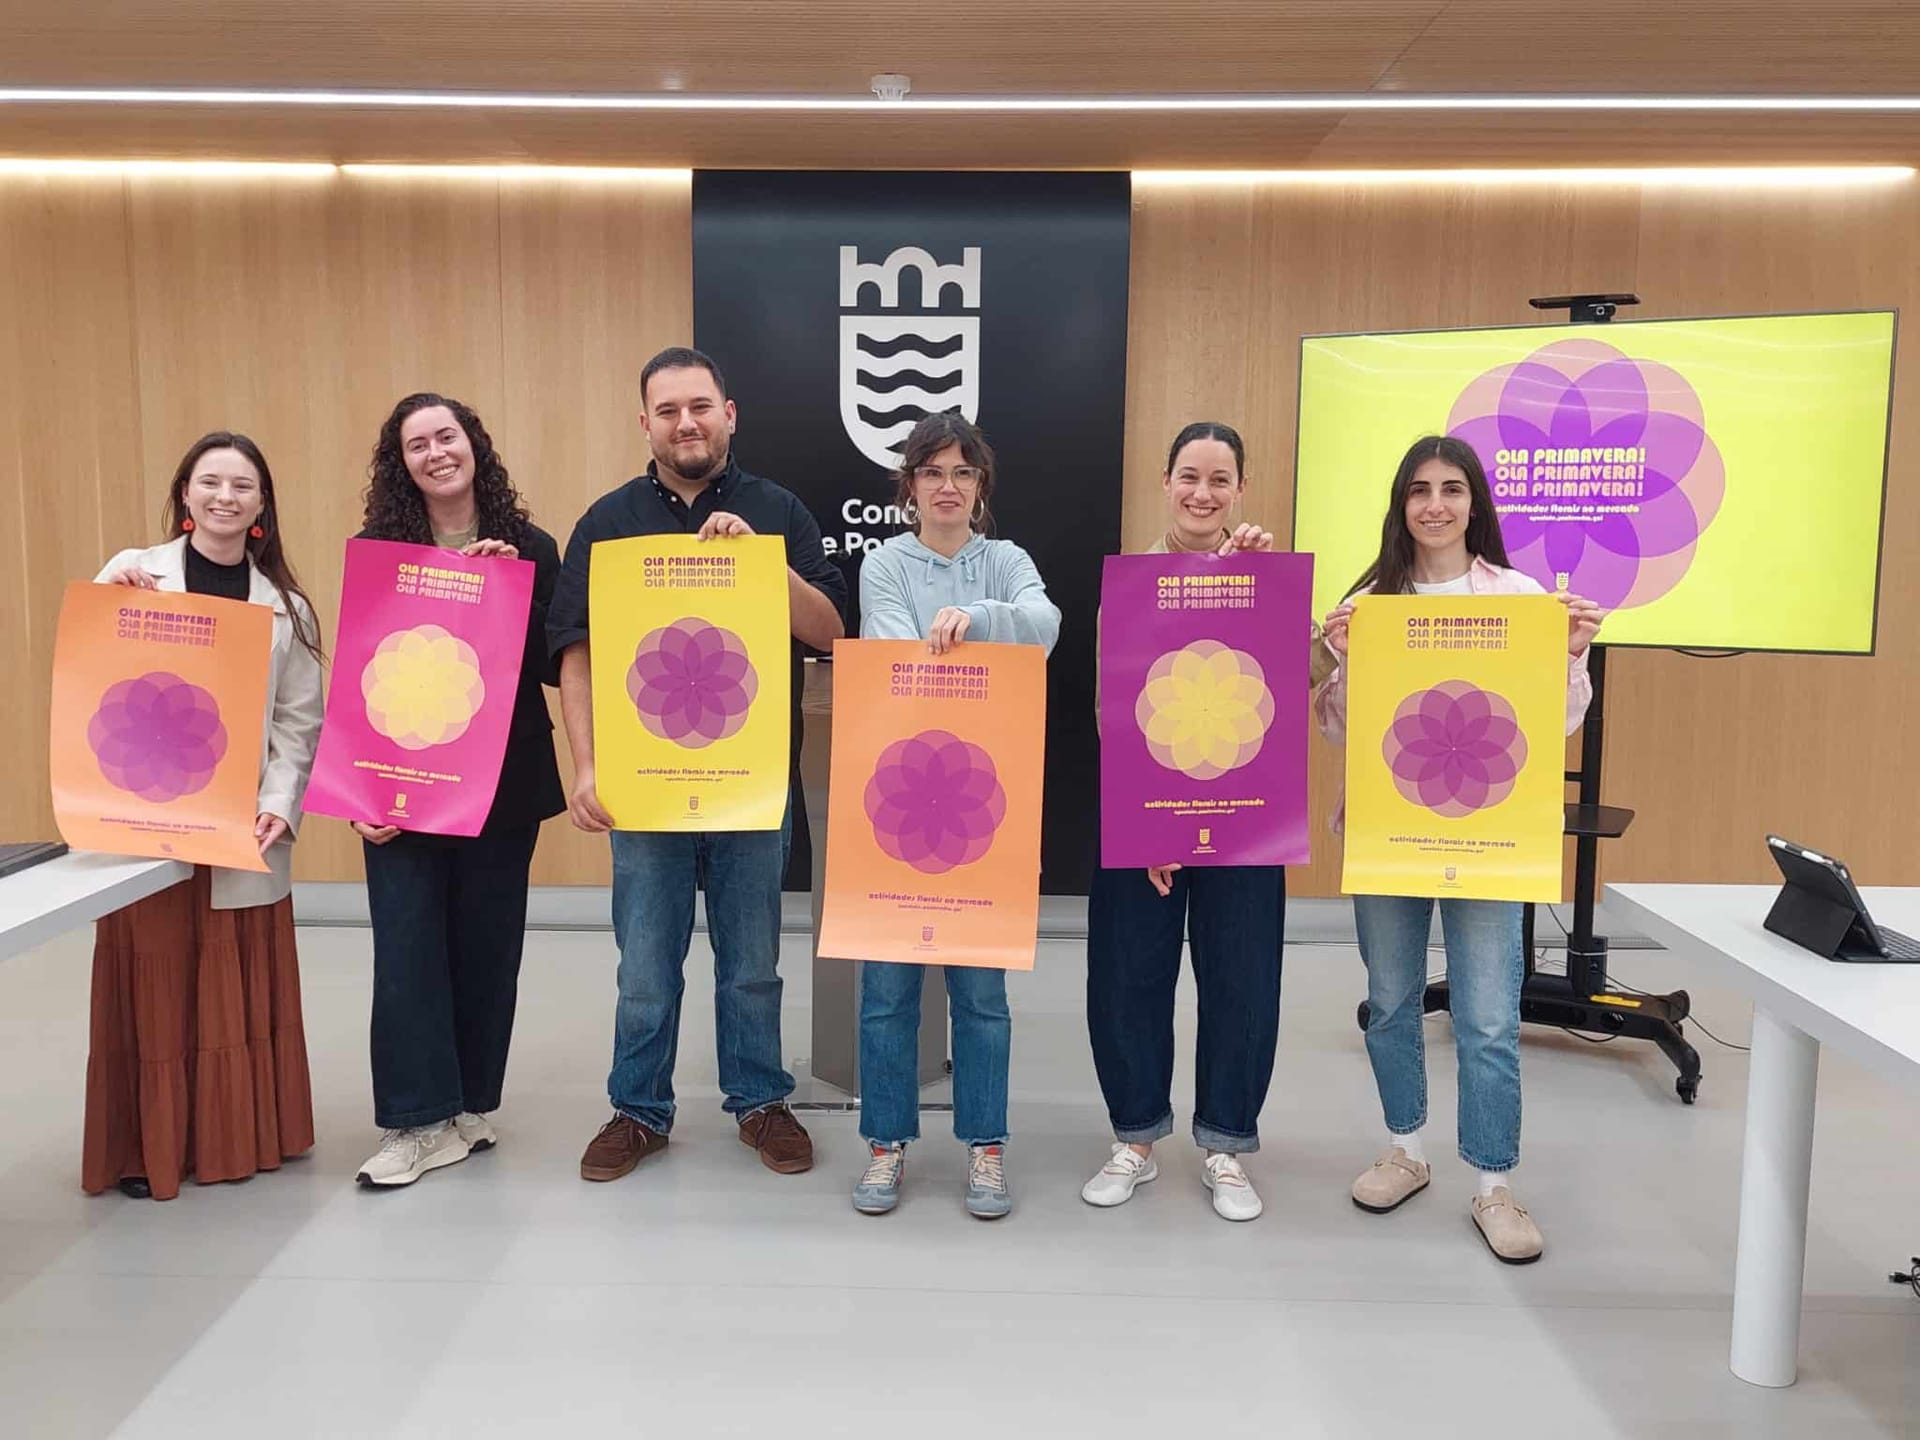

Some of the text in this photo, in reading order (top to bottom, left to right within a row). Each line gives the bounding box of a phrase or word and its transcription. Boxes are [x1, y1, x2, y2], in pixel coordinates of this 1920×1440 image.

[1495, 448, 1645, 464] OLA PRIMAVERA!
[1495, 465, 1644, 481] OLA PRIMAVERA!
[1494, 482, 1643, 497] OLA PRIMAVERA!
[842, 498, 917, 525] Conc
[1496, 504, 1548, 513] actividades
[1551, 504, 1580, 513] florais
[1597, 504, 1639, 513] mercado
[644, 557, 735, 566] OLA PRIMAVERA!
[398, 563, 485, 584] OLA PRIMAVERA!
[645, 568, 735, 577] OLA PRIMAVERA!
[397, 574, 483, 594] OLA PRIMAVERA!
[645, 579, 735, 587] OLA PRIMAVERA!
[1157, 575, 1255, 587] OLA PRIMAVERA!
[396, 584, 481, 604] OLA PRIMAVERA!
[1157, 587, 1255, 598] OLA PRIMAVERA!
[1157, 598, 1254, 609] OLA PRIMAVERA!
[119, 608, 217, 626] OLA PRIMAVERA!
[1408, 618, 1508, 627] OLA PRIMAVERA!
[118, 619, 216, 637] OLA PRIMAVERA!
[118, 629, 139, 639] OLA
[1408, 628, 1508, 638] OLA PRIMAVERA!
[1407, 640, 1508, 649] OLA PRIMAVERA!
[892, 663, 988, 676] OLA PRIMAVERA!
[892, 675, 988, 688] OLA PRIMAVERA!
[892, 686, 988, 700] OLA PRIMAVERA!
